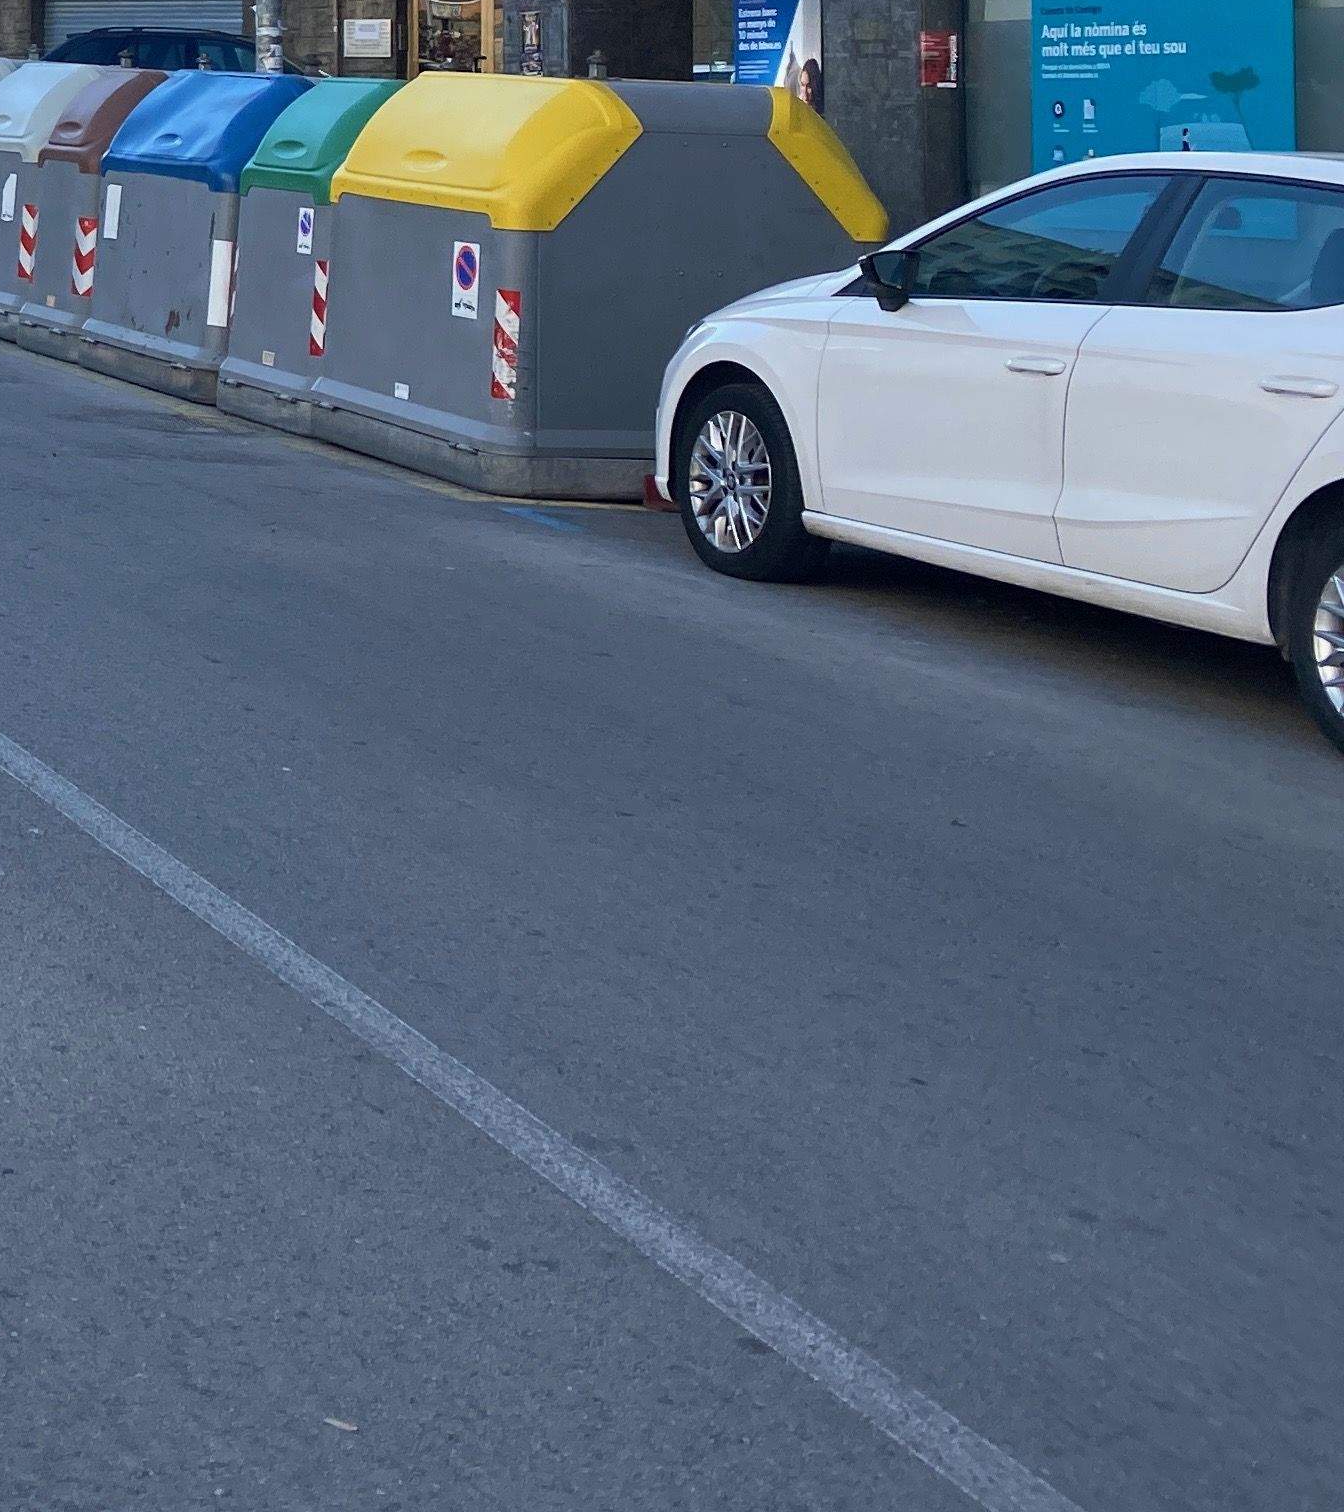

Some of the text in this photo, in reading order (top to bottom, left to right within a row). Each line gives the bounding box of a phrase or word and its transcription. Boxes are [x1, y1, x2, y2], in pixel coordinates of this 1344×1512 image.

[1041, 19, 1148, 42] Aquí la nòmina és
[1041, 39, 1188, 59] molt més que el teu sou
